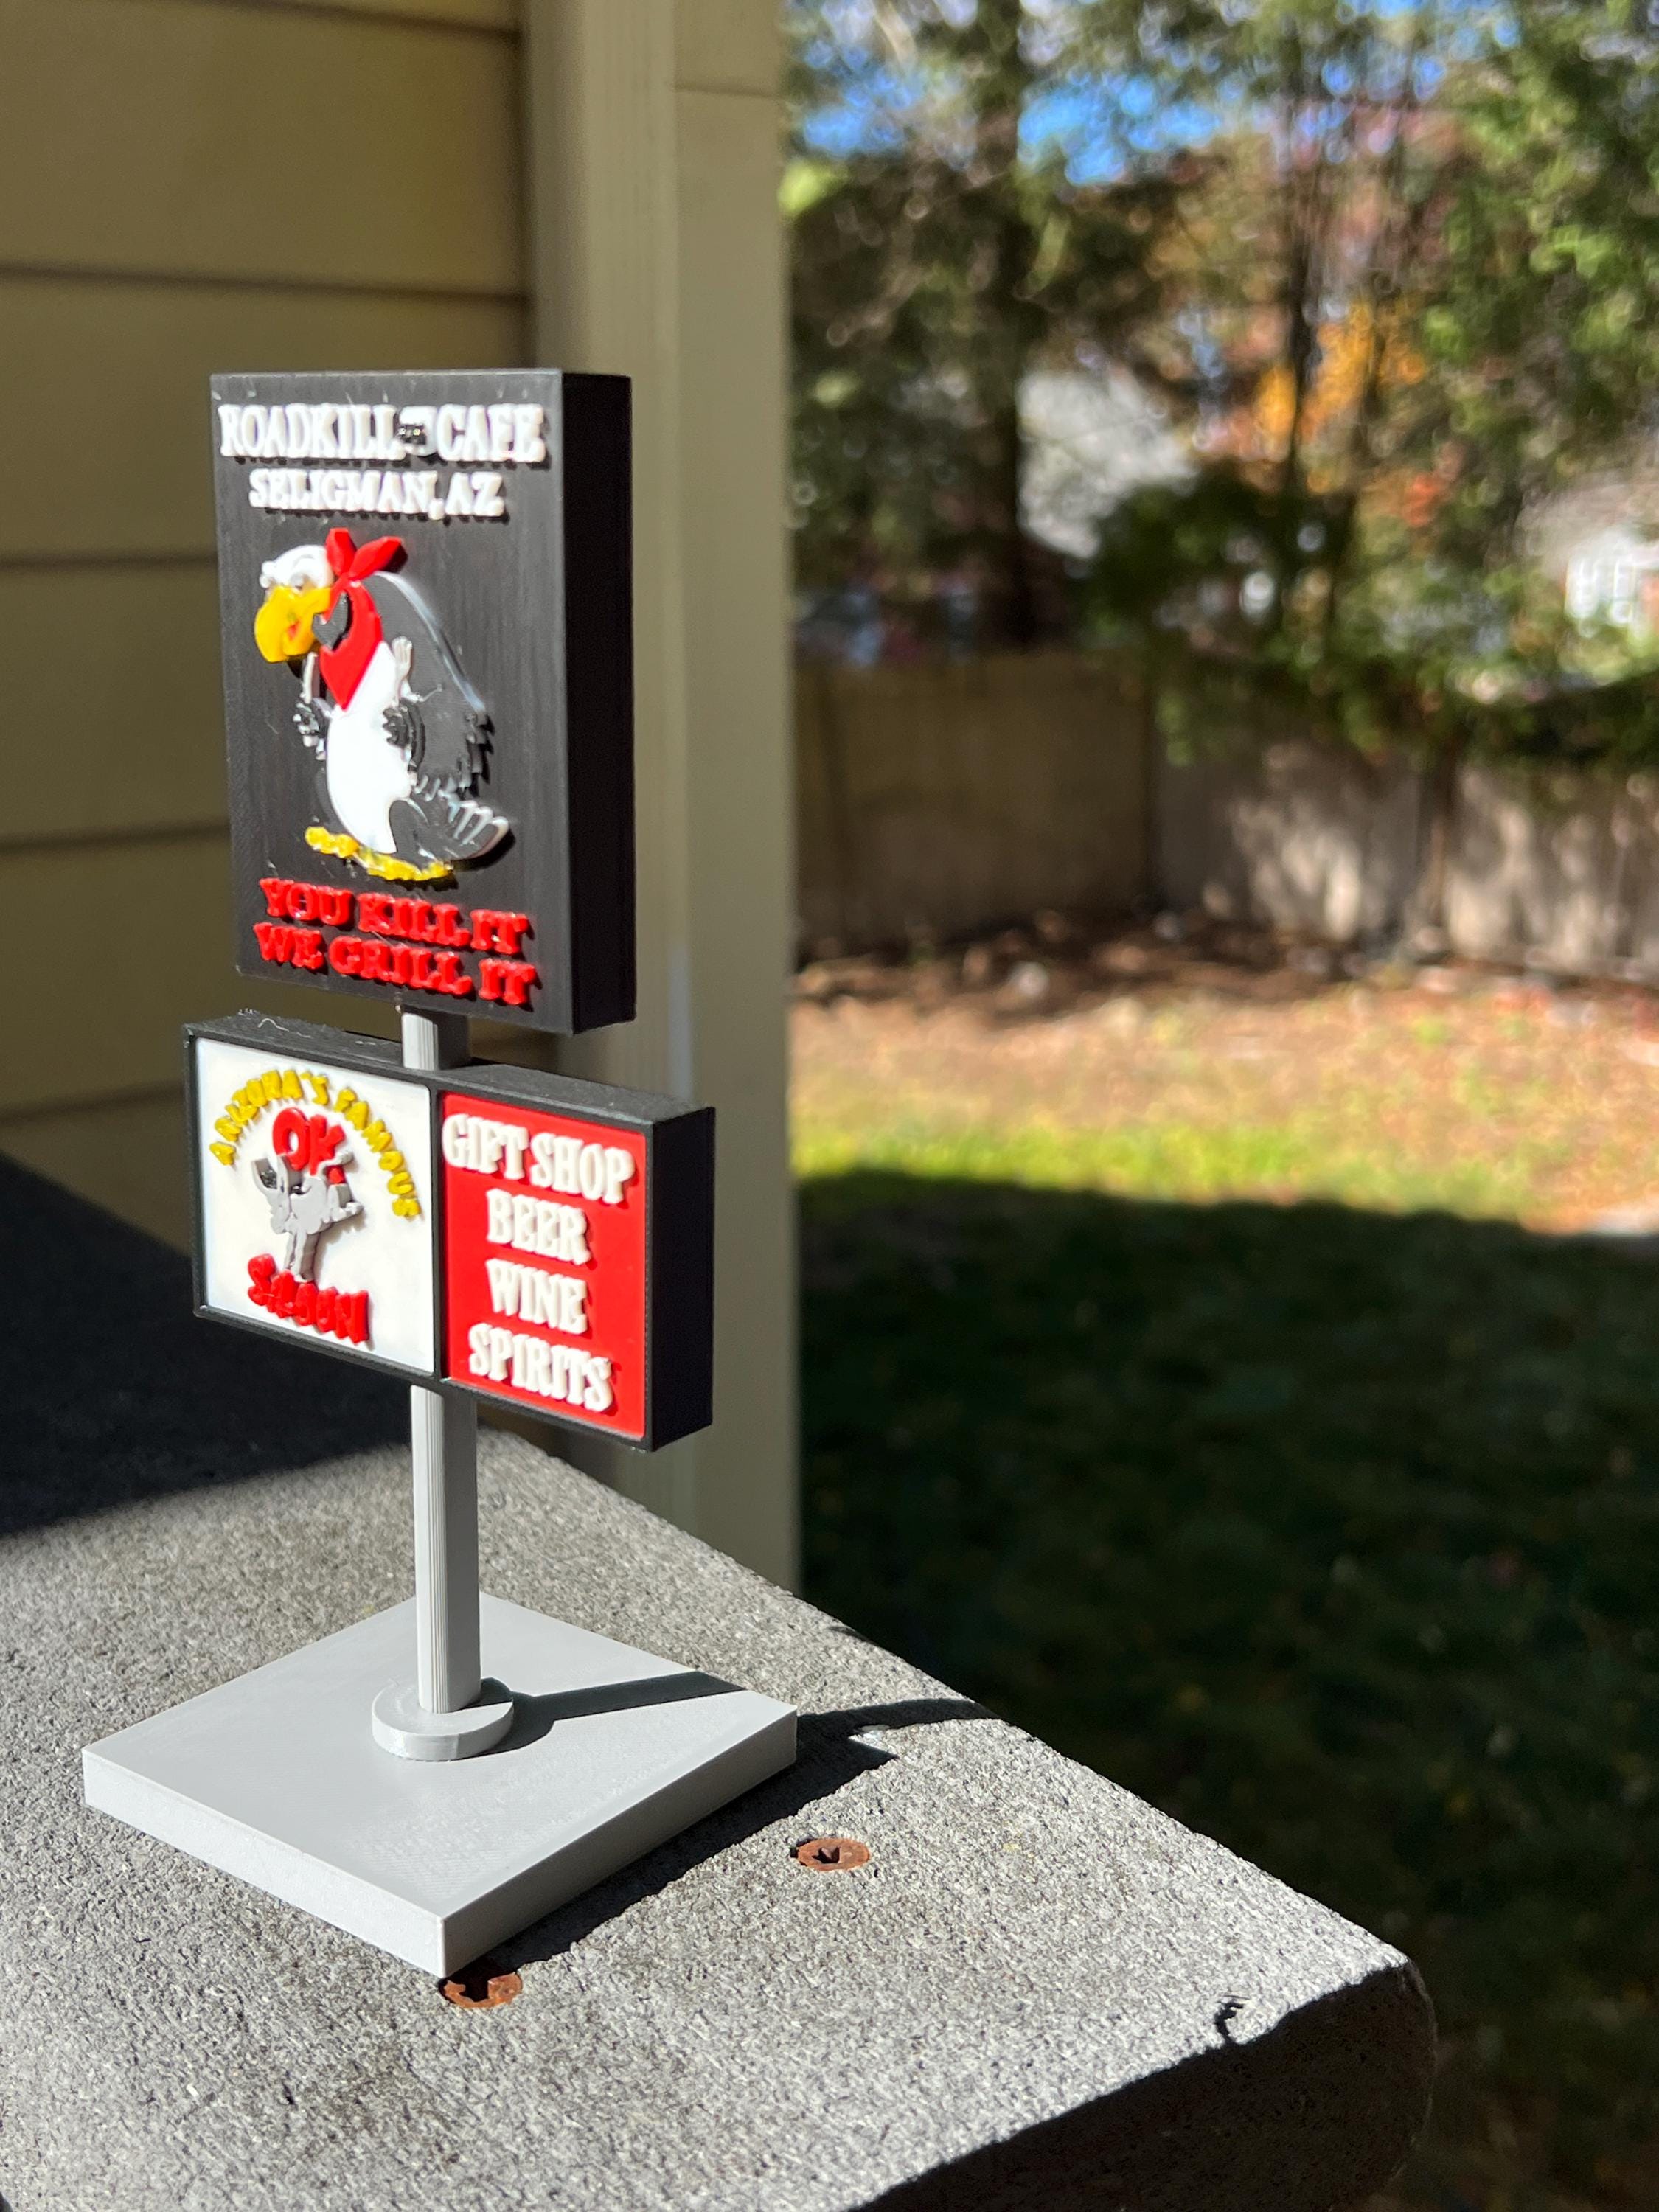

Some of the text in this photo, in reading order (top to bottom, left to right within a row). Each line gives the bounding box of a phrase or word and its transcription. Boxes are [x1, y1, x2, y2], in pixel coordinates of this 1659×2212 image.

[218, 403, 547, 462] ROADKILL CAFE
[445, 471, 505, 517] AZ
[259, 877, 529, 955] YOU KILL IT
[253, 922, 538, 1006] WE GRILL IT
[272, 1107, 346, 1180] OK
[333, 1086, 422, 1217] FAMOUS
[442, 1114, 636, 1204] GIFT SHOP
[486, 1188, 591, 1265] BEER
[247, 1254, 369, 1344] SALOON
[485, 1258, 588, 1335] WINE
[468, 1322, 613, 1413] SPIRITS
